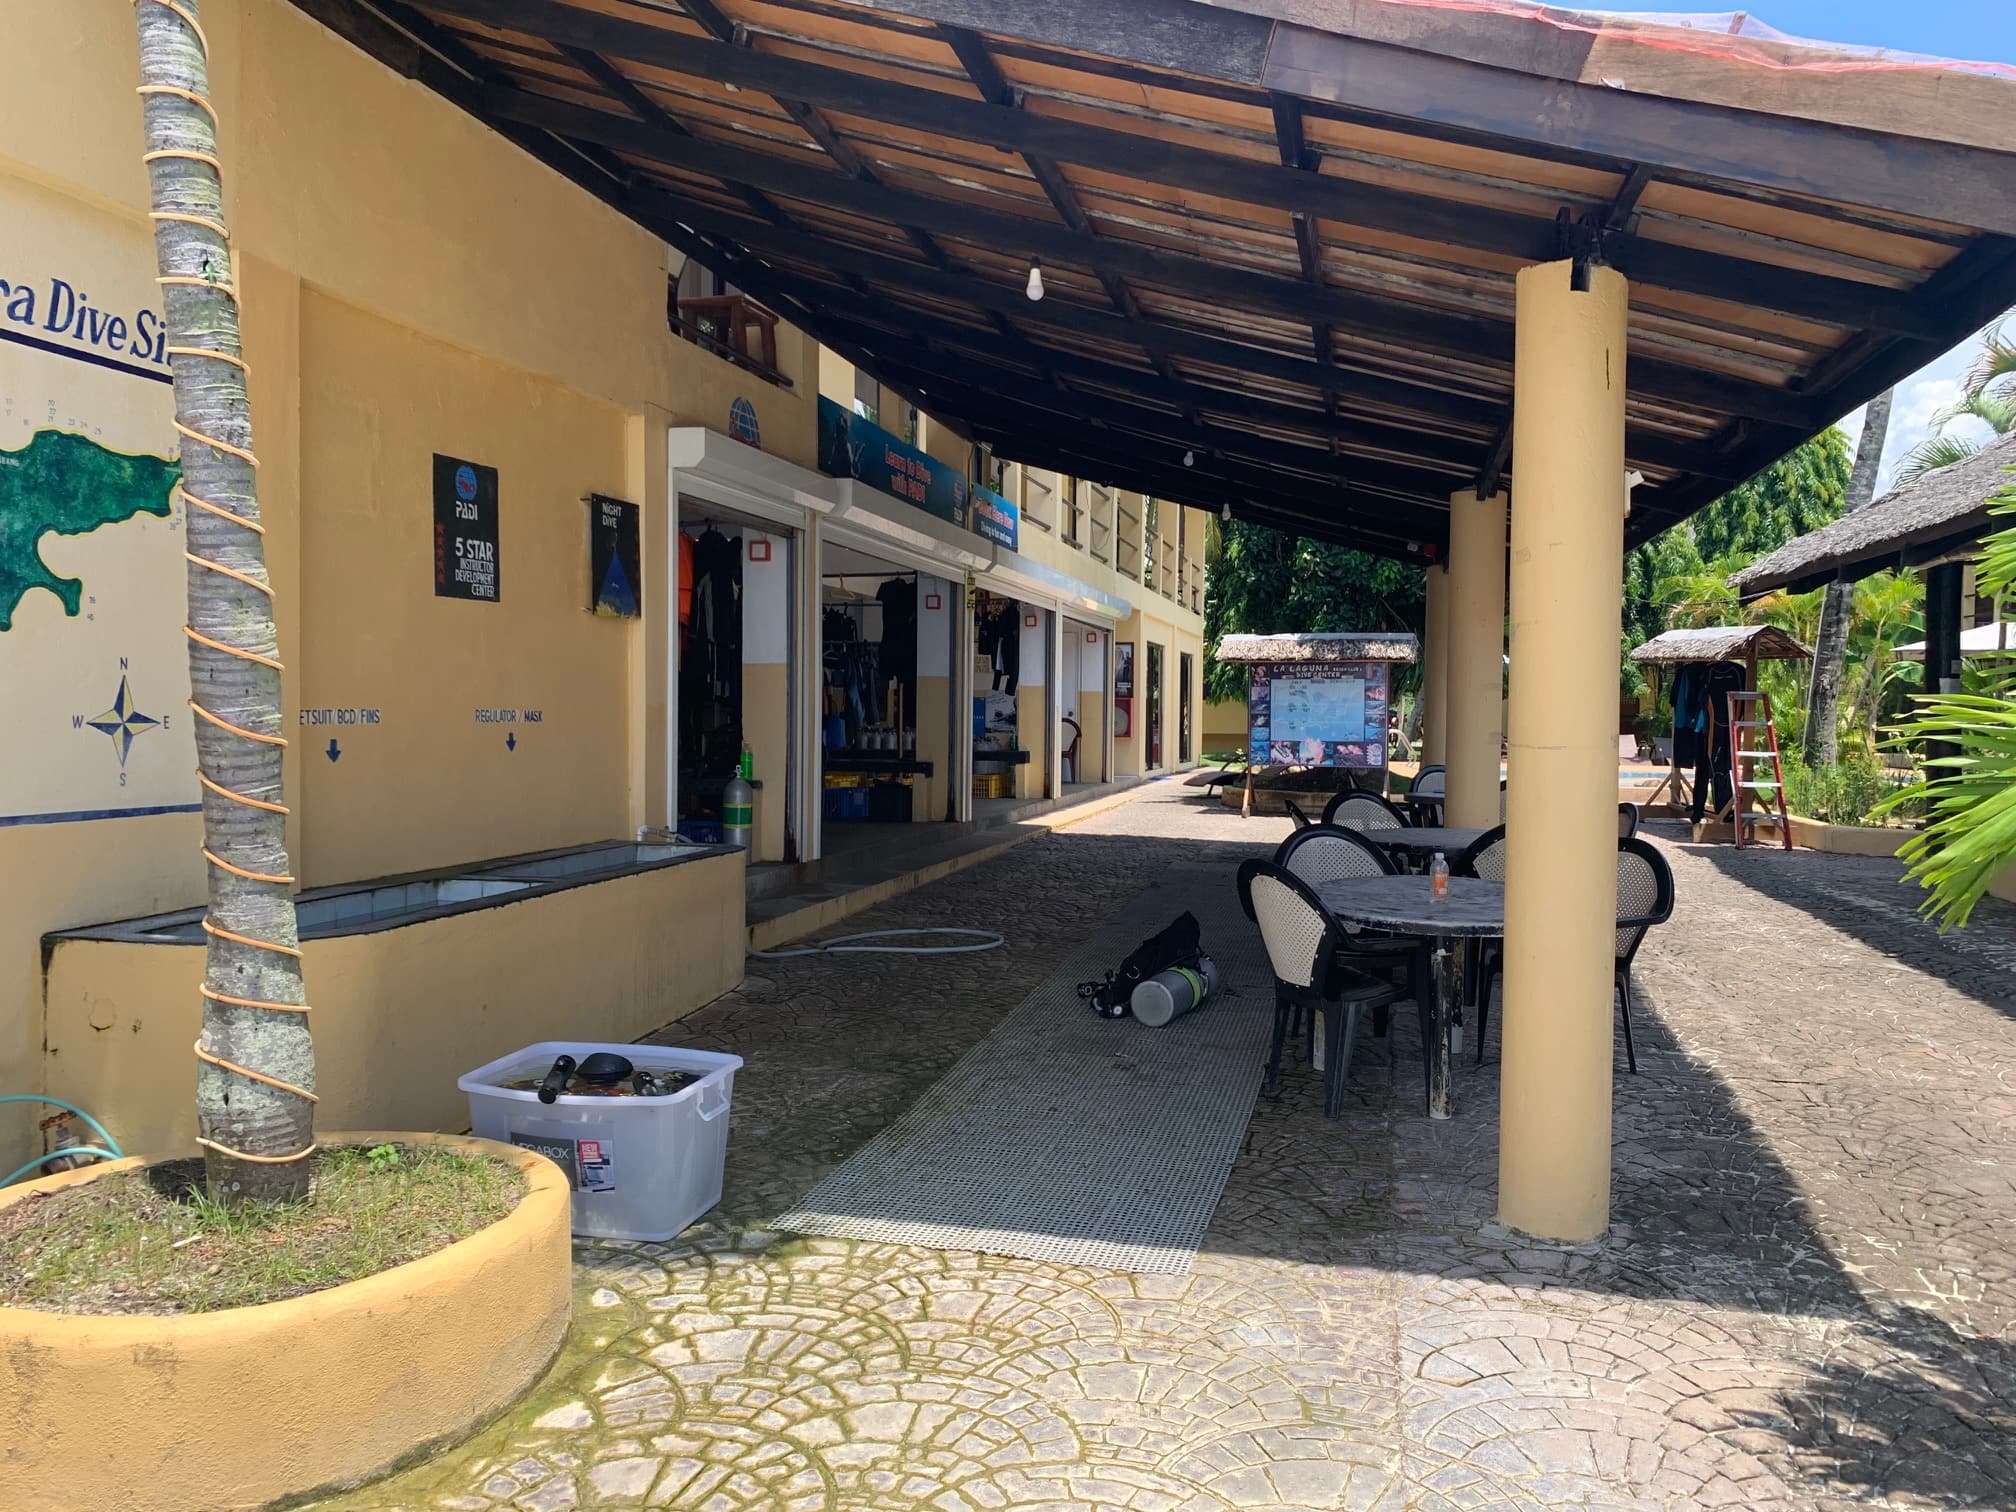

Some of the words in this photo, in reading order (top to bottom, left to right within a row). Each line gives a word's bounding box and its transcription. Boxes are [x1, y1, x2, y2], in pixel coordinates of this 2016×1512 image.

[43, 277, 127, 352] Dive
[130, 309, 172, 367] Si
[455, 501, 478, 520] PADI
[455, 537, 464, 557] 5
[466, 539, 494, 562] STAR
[460, 558, 494, 574] INSTRUCTOR
[455, 570, 494, 586] DEVELOPMENT
[471, 584, 495, 597] CENTER
[120, 657, 128, 669] N
[1289, 664, 1329, 672] LAGUNA
[72, 716, 84, 729] W
[163, 717, 170, 729] E
[475, 709, 517, 723] REGULATOR
[524, 710, 543, 722] MASK
[120, 773, 126, 786] S
